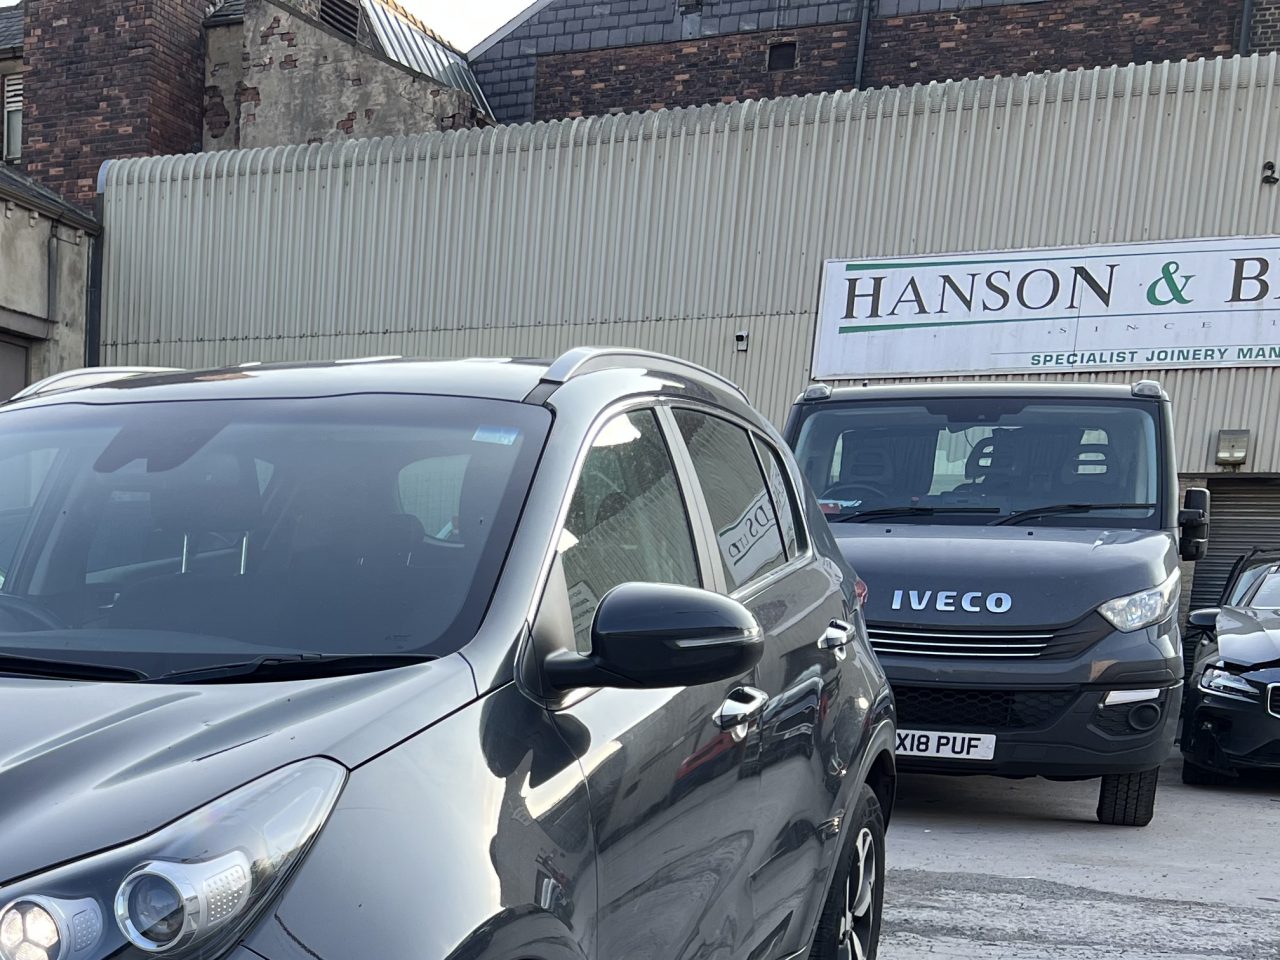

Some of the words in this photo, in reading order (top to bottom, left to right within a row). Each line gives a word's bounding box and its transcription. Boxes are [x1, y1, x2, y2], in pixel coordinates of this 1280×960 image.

[840, 263, 1119, 320] HANSON
[1146, 260, 1195, 306] &
[1224, 256, 1280, 303] B
[1030, 350, 1138, 366] SPECIALIST
[1145, 347, 1229, 362] JOINERY
[891, 589, 1012, 613] IVECO
[935, 735, 982, 756] PUF
